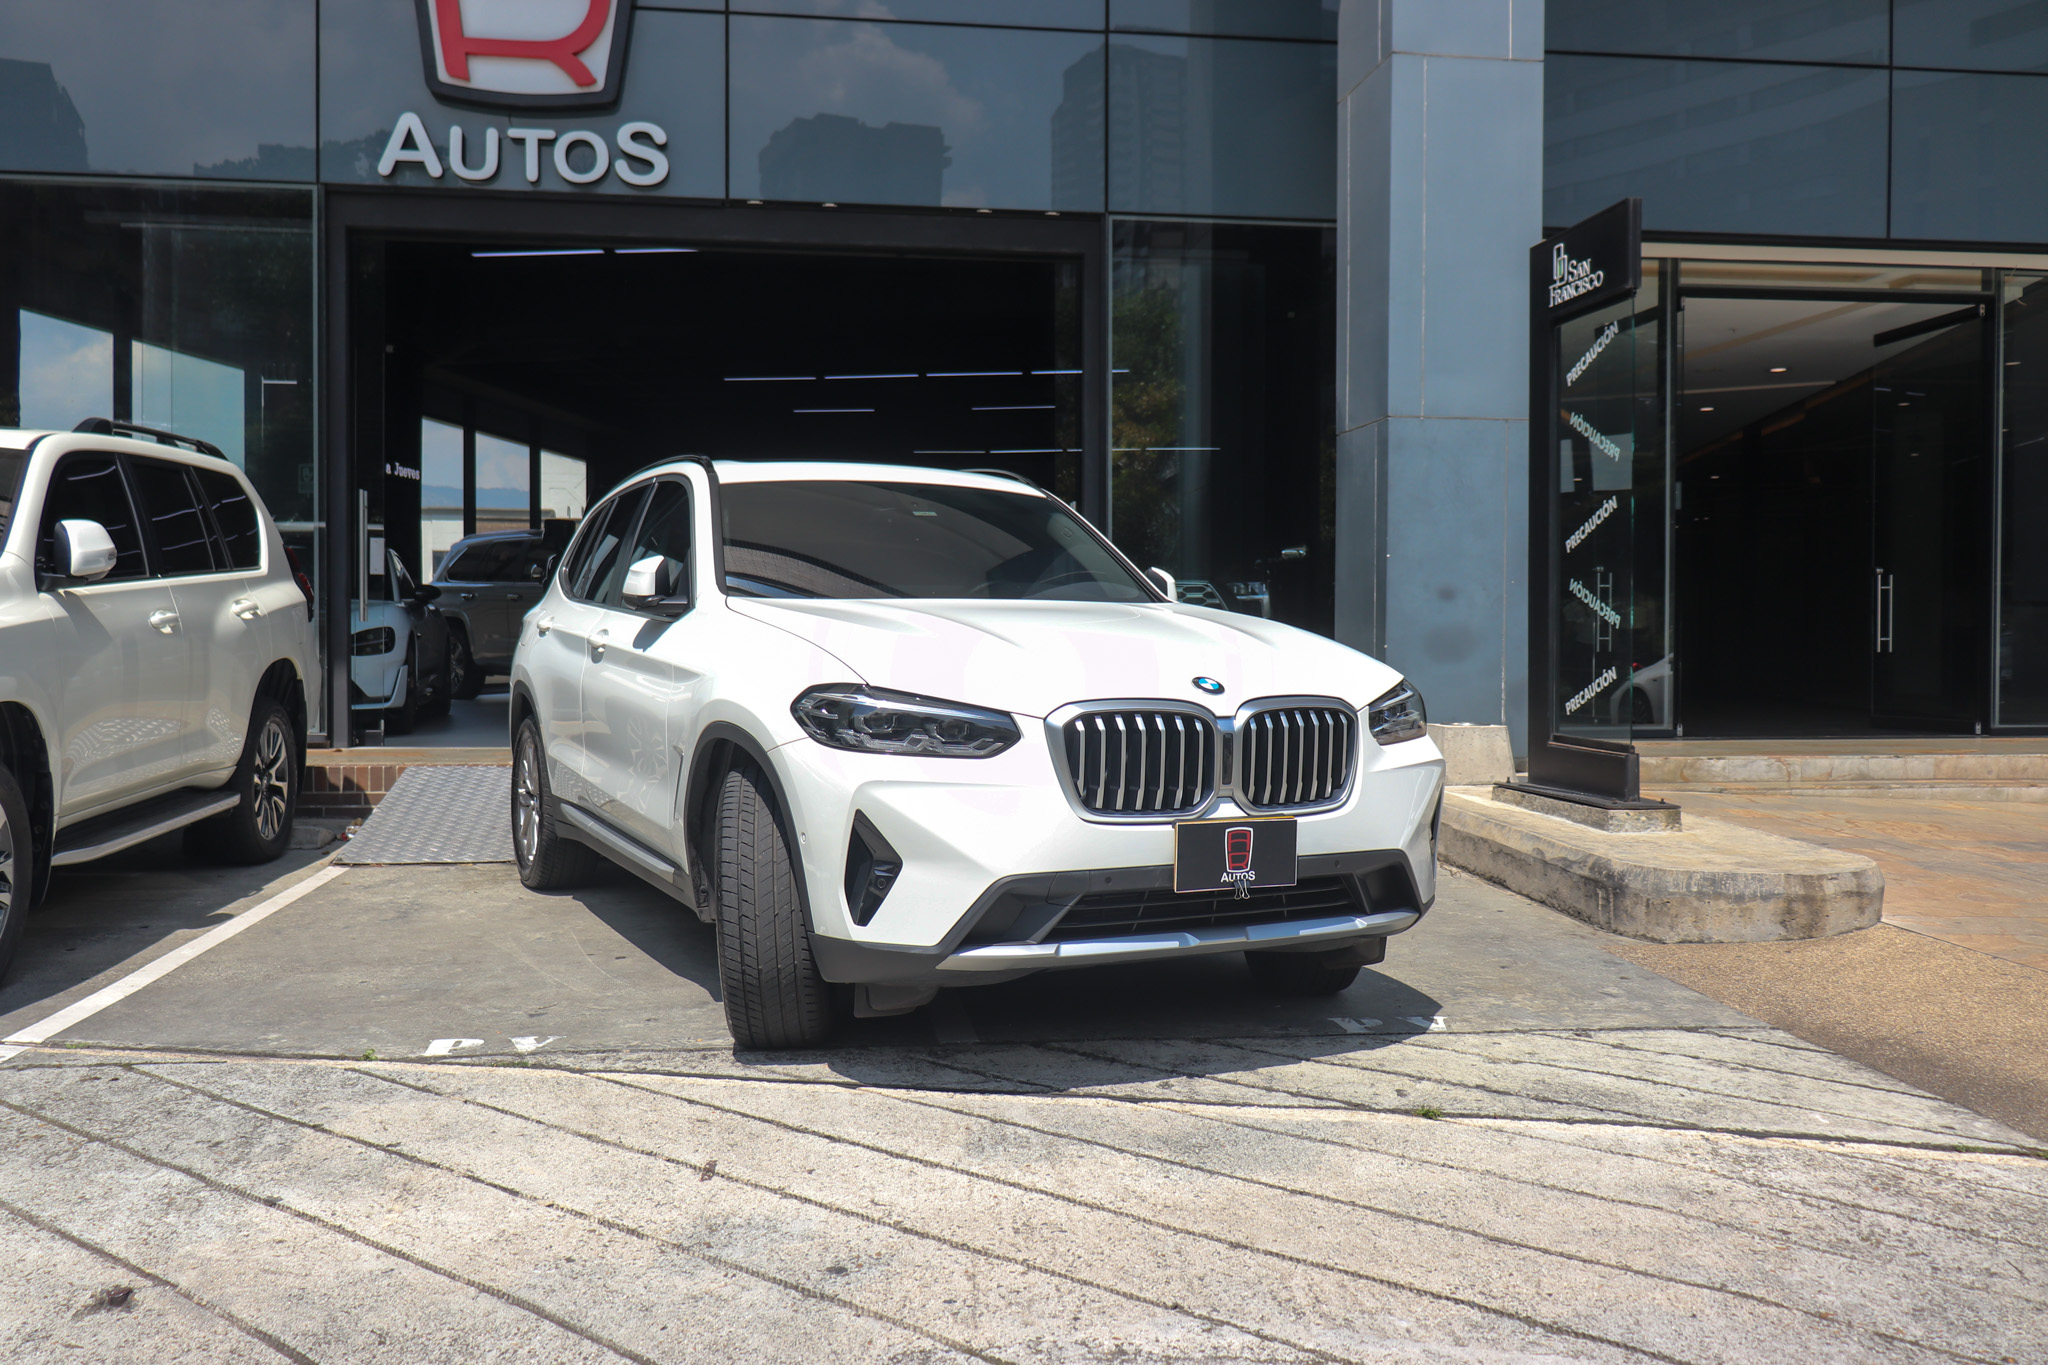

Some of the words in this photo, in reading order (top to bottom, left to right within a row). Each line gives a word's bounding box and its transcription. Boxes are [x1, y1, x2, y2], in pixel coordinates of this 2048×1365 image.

[378, 112, 670, 186] AUTOS
[1549, 270, 1604, 308] FRANCISCO
[1568, 258, 1591, 283] SAN
[1566, 320, 1620, 387] PRECAUCIÓN
[1565, 495, 1618, 554] PRECAUCIÓN
[1565, 666, 1618, 716] PRECAUCIÓN
